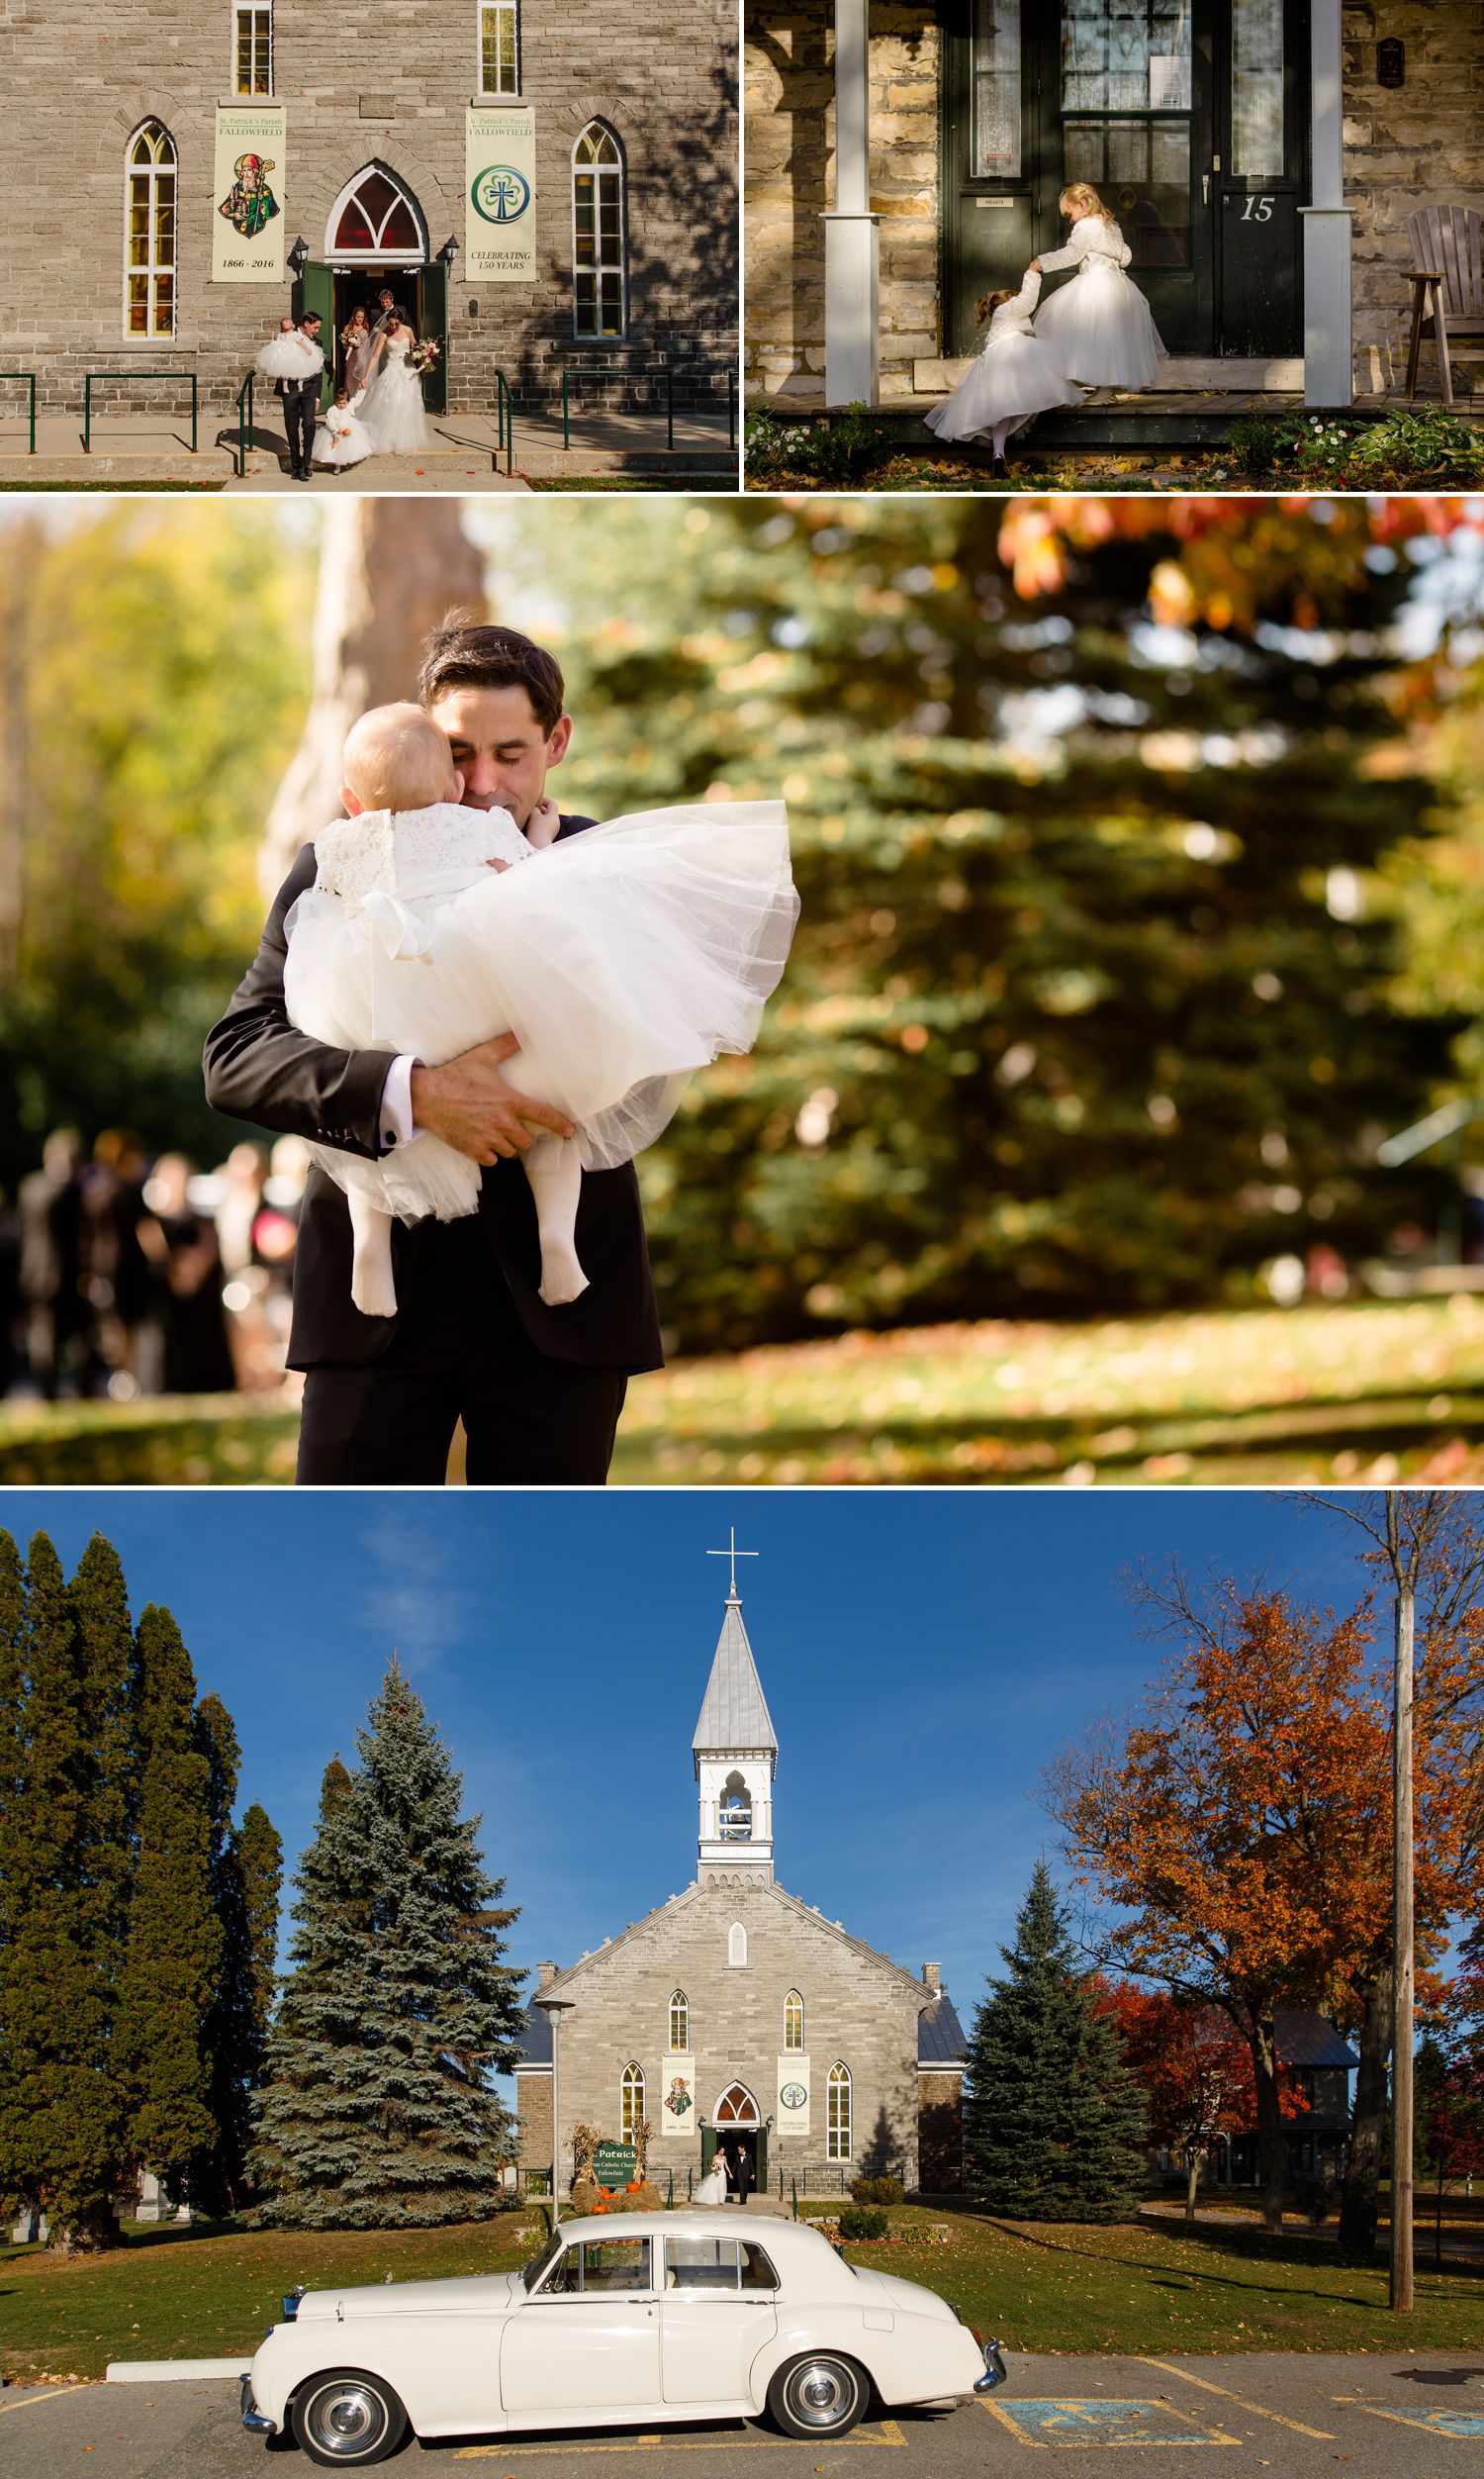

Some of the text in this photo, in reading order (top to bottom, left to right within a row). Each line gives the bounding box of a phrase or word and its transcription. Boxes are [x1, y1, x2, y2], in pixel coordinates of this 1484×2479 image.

[1240, 196, 1275, 222] 15
[223, 259, 244, 268] 1866
[251, 259, 275, 268] 2016
[599, 2149, 637, 2158] Patrick
